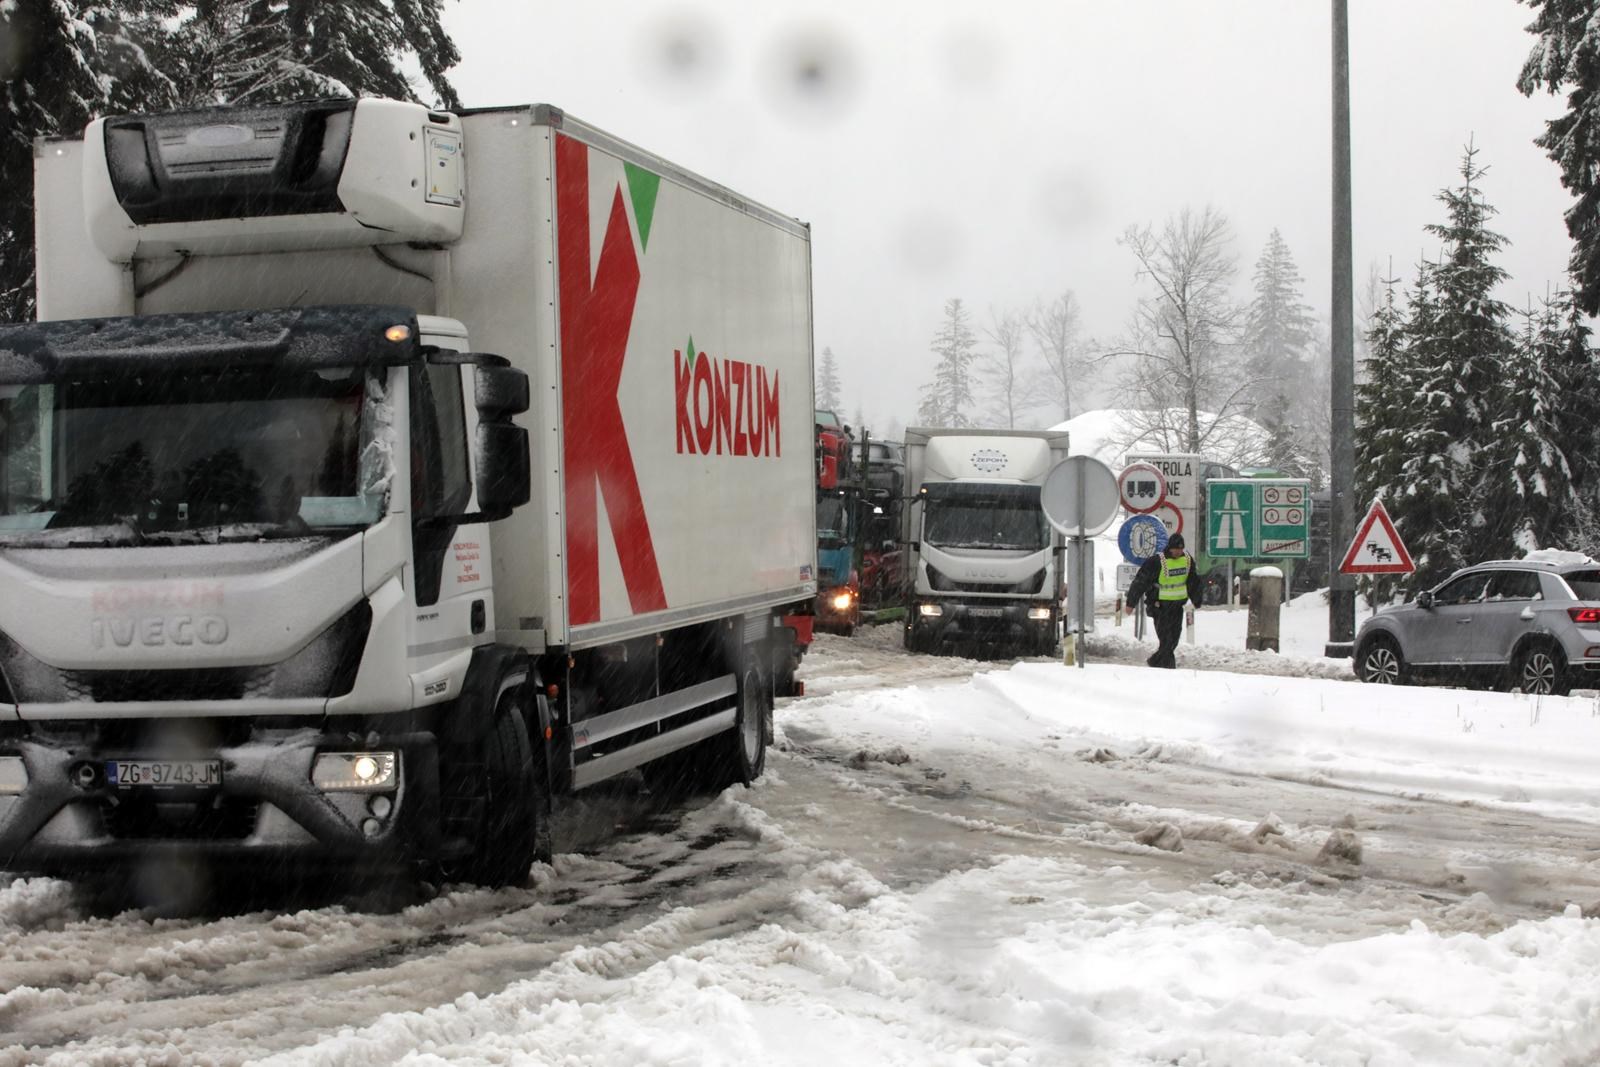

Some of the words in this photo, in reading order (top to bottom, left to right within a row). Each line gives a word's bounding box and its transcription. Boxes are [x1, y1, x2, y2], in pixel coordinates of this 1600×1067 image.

[674, 349, 780, 458] KONZUM
[1133, 460, 1192, 476] TROLA
[91, 613, 230, 649] IVECO
[119, 764, 140, 783] ZG
